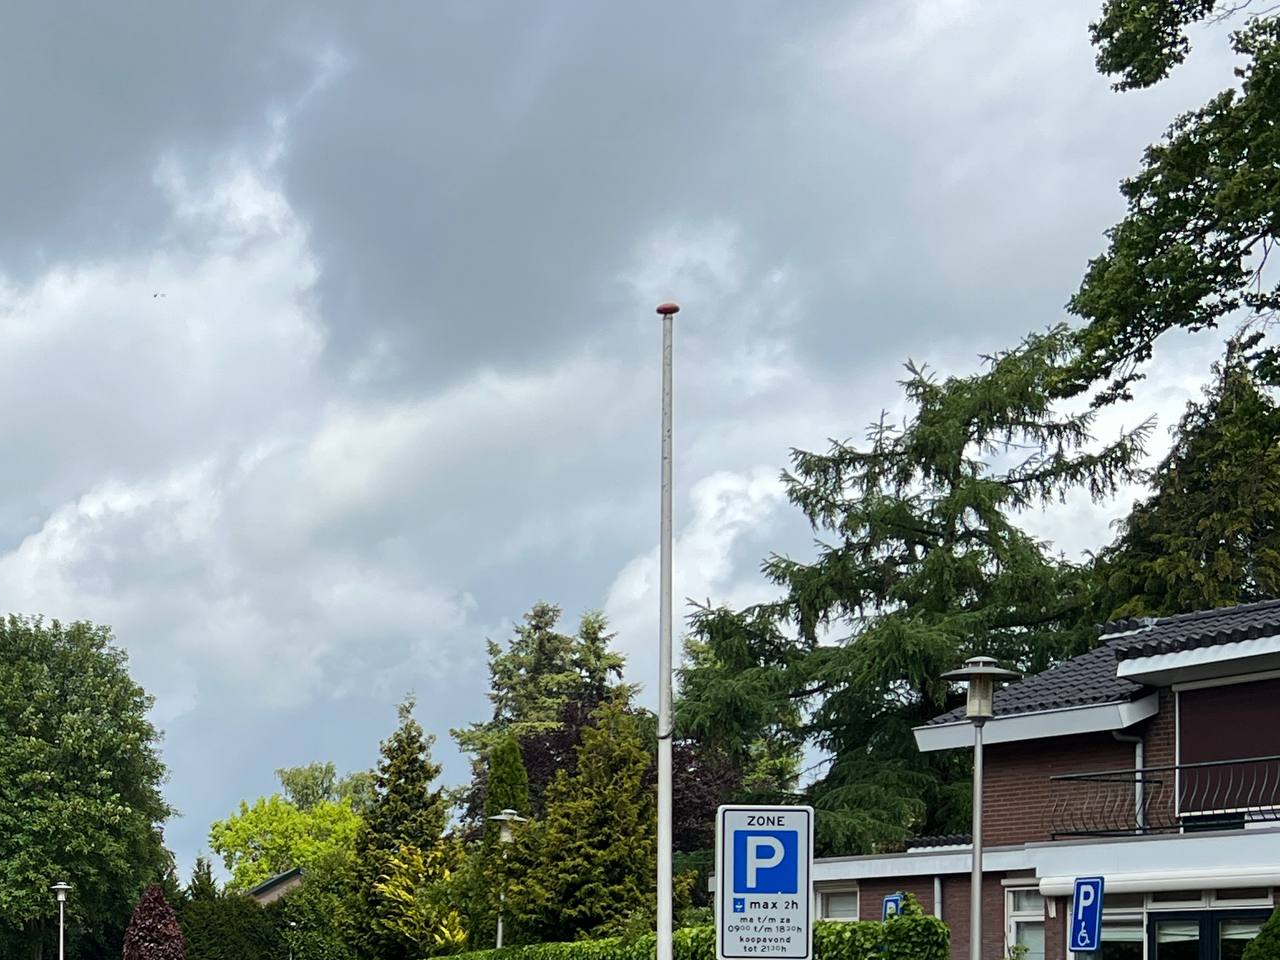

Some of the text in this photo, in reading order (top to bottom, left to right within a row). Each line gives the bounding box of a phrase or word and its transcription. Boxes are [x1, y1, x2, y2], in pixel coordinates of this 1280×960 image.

[747, 816, 785, 826] ZONE
[746, 836, 785, 889] P
[750, 900, 799, 910] max 2h
[1077, 884, 1095, 920] P
[757, 915, 777, 924] t/m
[754, 925, 773, 933] t/m
[740, 936, 791, 944] koopavond
